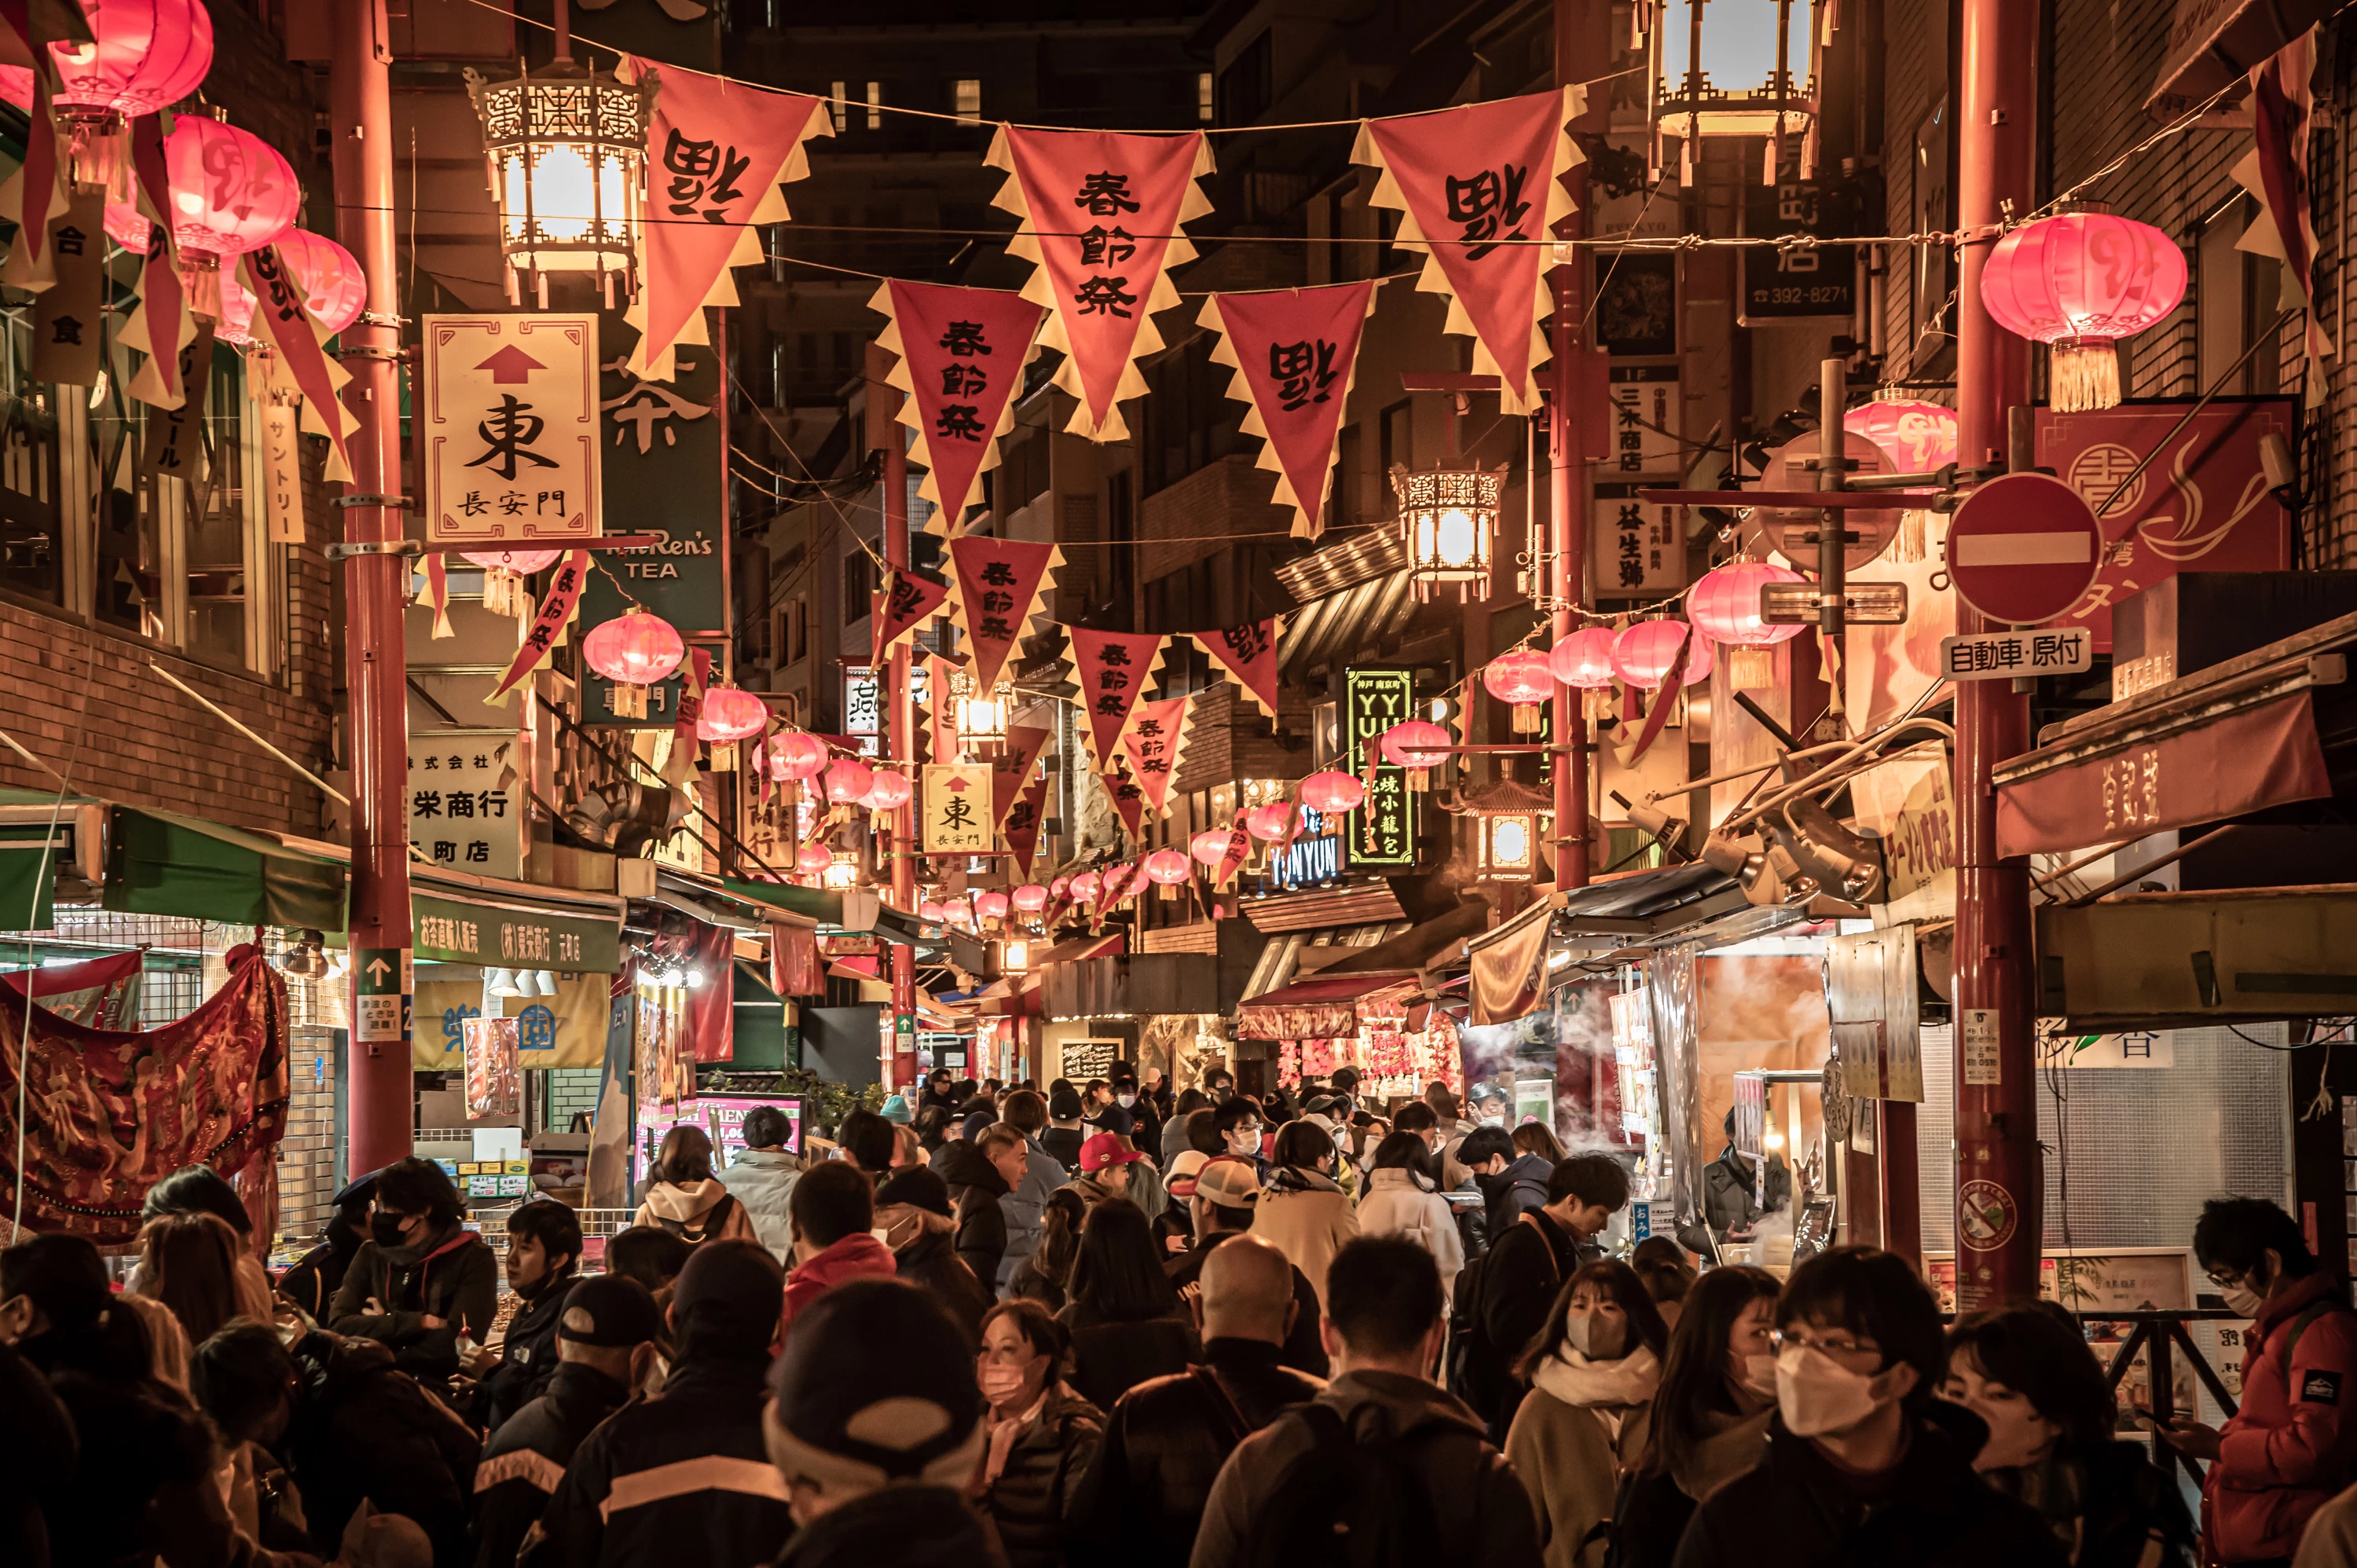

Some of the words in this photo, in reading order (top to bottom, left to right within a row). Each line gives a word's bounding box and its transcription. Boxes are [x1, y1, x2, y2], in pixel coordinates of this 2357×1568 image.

[663, 128, 750, 224] 福
[1446, 163, 1533, 262] 福
[1075, 170, 1140, 318] 春節祭
[1772, 286, 1847, 304] 392-8271
[937, 320, 992, 442] 春節祭
[1269, 339, 1338, 412] 福
[464, 394, 560, 482] 東
[1619, 390, 1642, 471] 三木商店
[269, 421, 294, 535] サントリー
[457, 490, 566, 518] 長安門
[625, 562, 679, 578] TEA
[635, 529, 712, 556] Ren's
[526, 567, 578, 654] 春節祭
[980, 561, 1017, 642] 春節祭
[1097, 643, 1131, 718] 春節祭
[1357, 680, 1373, 690] 神戸
[1376, 680, 1401, 690] 南京町
[1951, 632, 2083, 673] 自動車・原付
[1137, 719, 1169, 774] 春節祭
[413, 790, 509, 819] 栄商行
[936, 833, 981, 845] 長安門
[939, 796, 977, 830] 東
